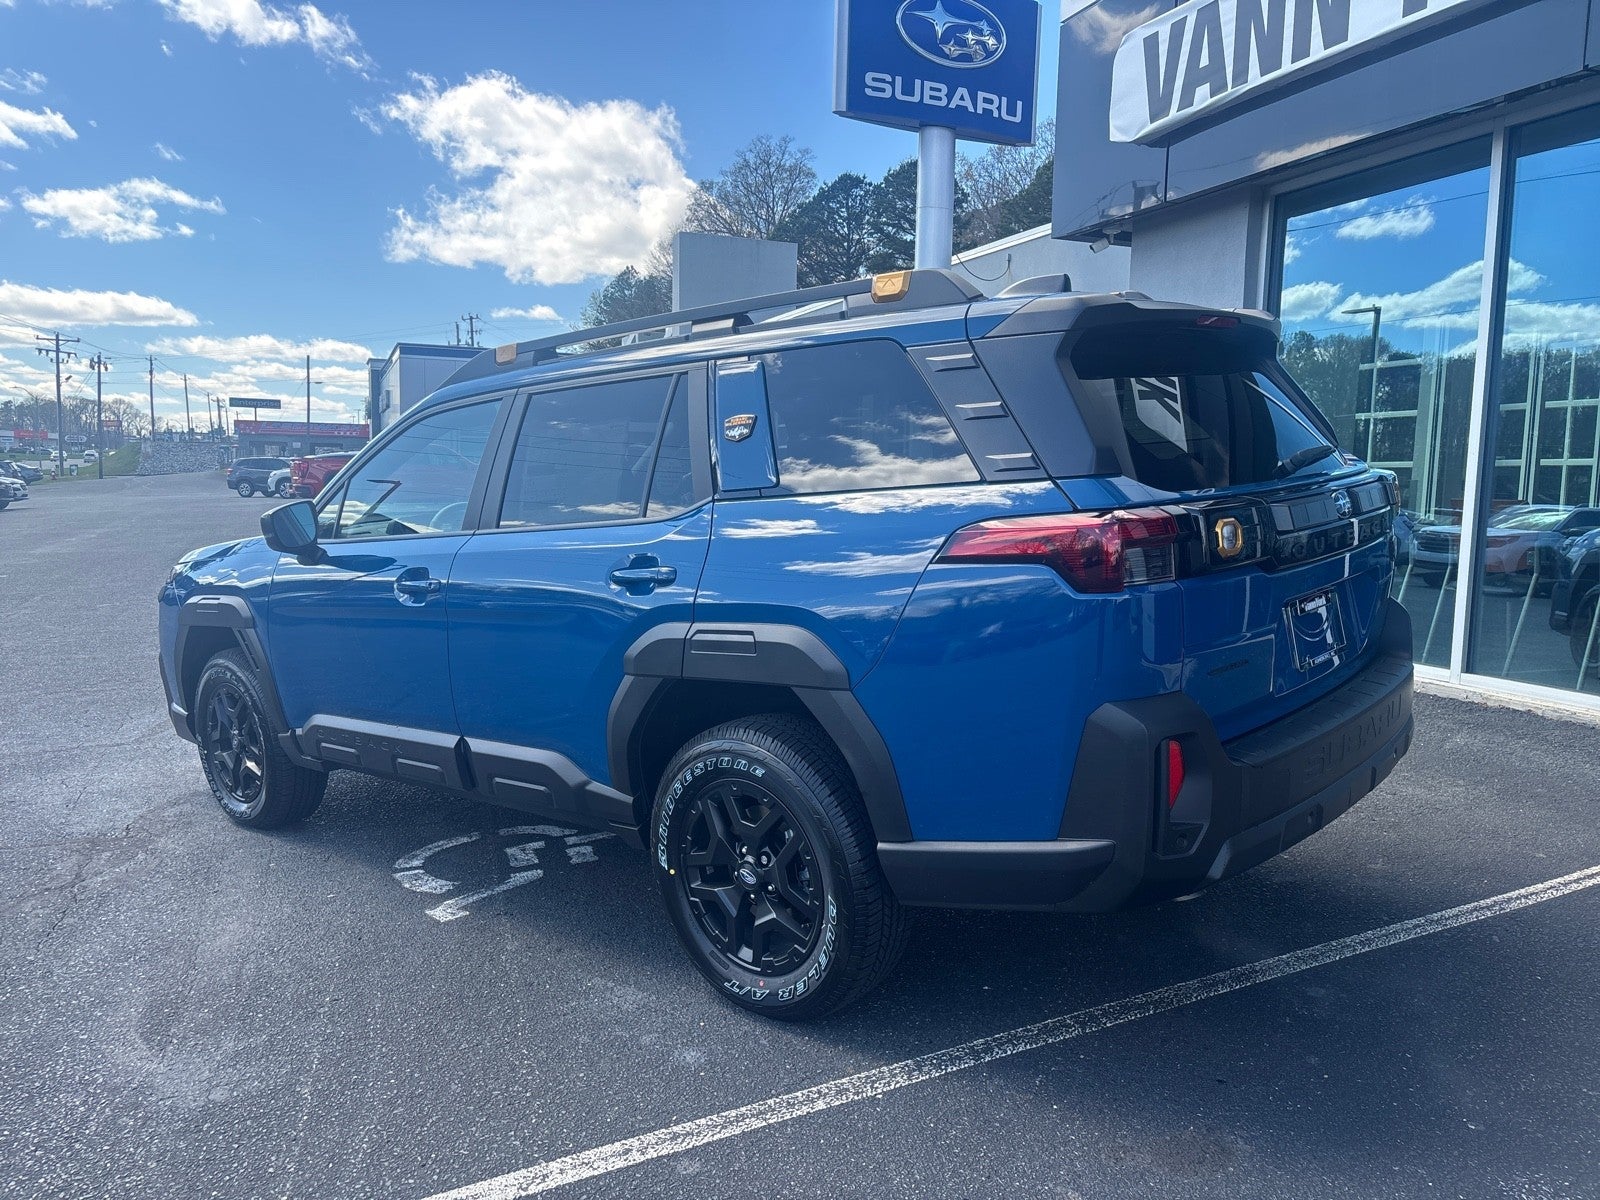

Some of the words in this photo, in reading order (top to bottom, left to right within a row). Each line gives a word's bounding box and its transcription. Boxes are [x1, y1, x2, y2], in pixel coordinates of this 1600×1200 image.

[864, 71, 1023, 124] SUBARU
[317, 729, 403, 754] OUTBACK
[657, 756, 766, 871] BRIDGESTONE
[777, 894, 838, 1001] DUELER
[723, 979, 770, 1001] A/T
